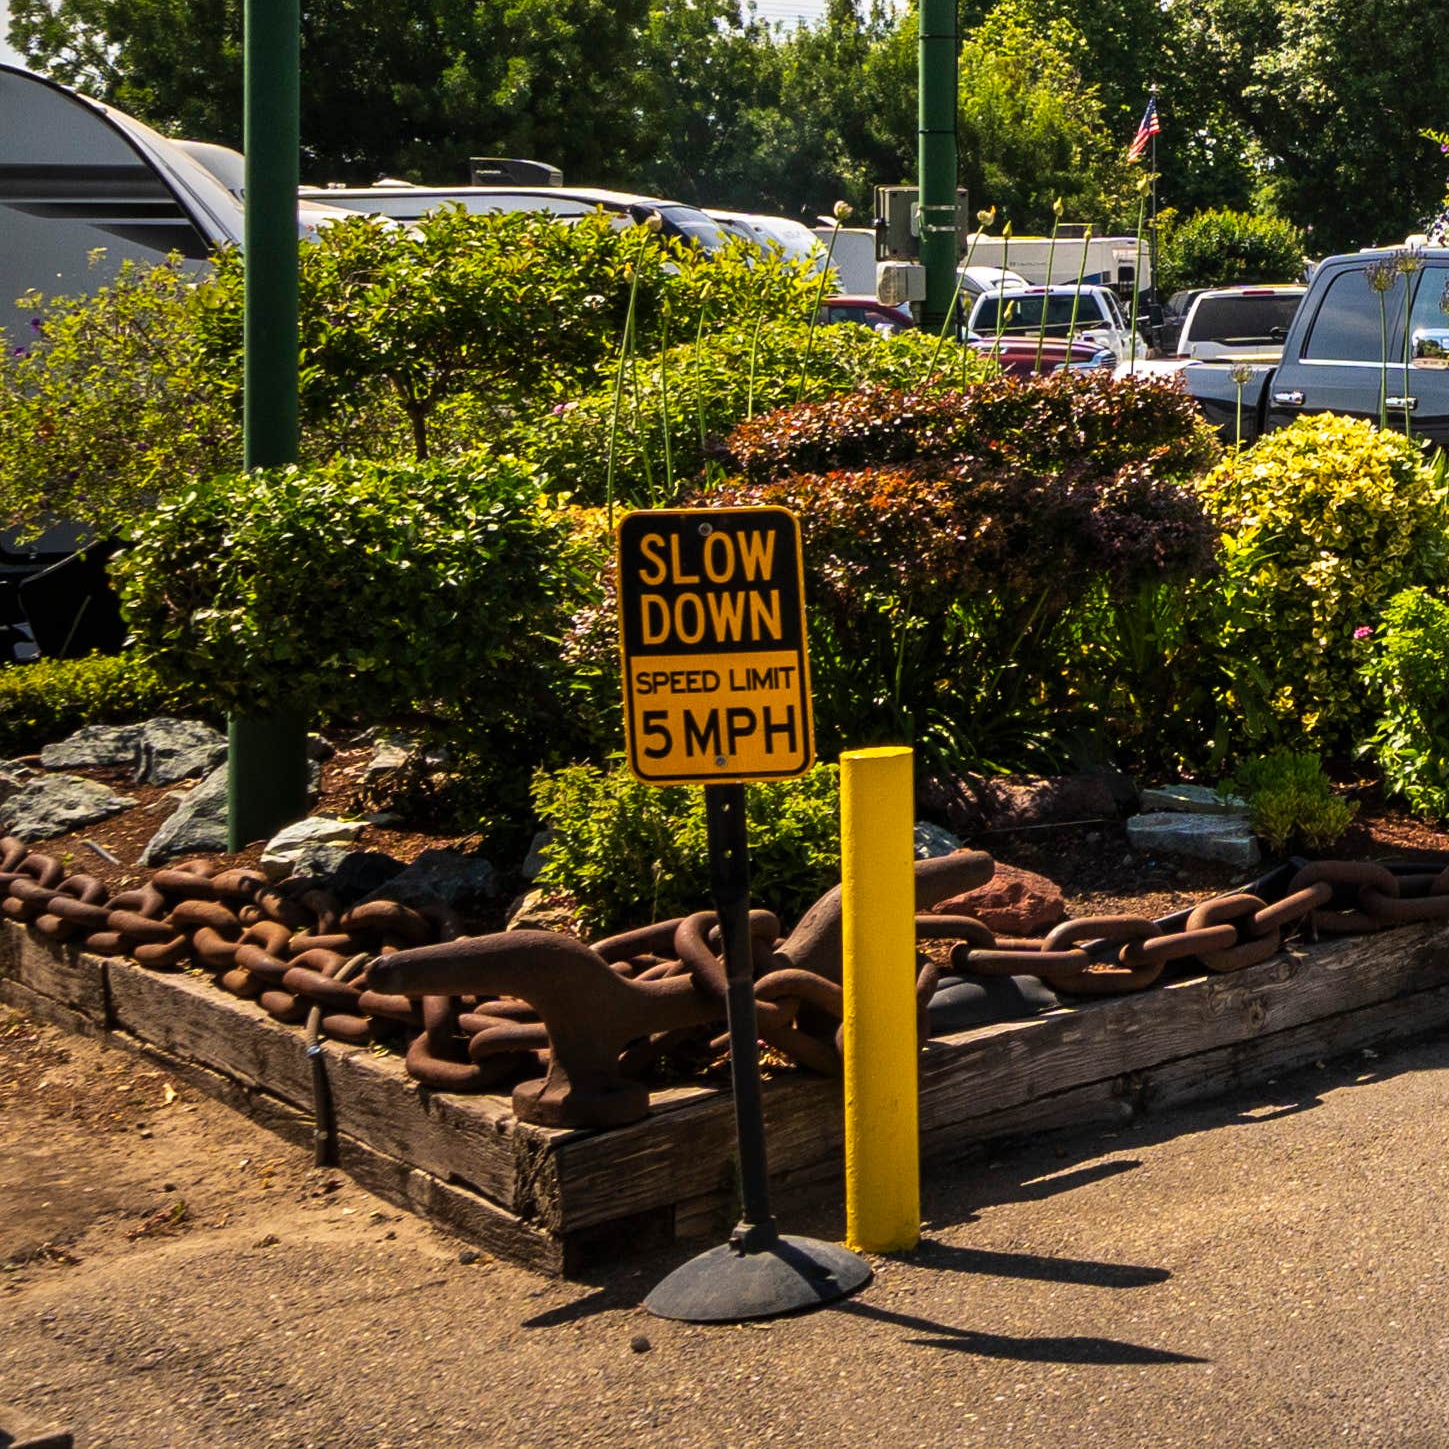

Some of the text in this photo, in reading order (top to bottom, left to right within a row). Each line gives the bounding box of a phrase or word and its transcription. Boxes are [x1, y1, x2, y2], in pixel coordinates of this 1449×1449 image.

[638, 530, 776, 586] SLOW
[640, 589, 783, 645] DOWN
[635, 666, 796, 695] SPEED LIMIT
